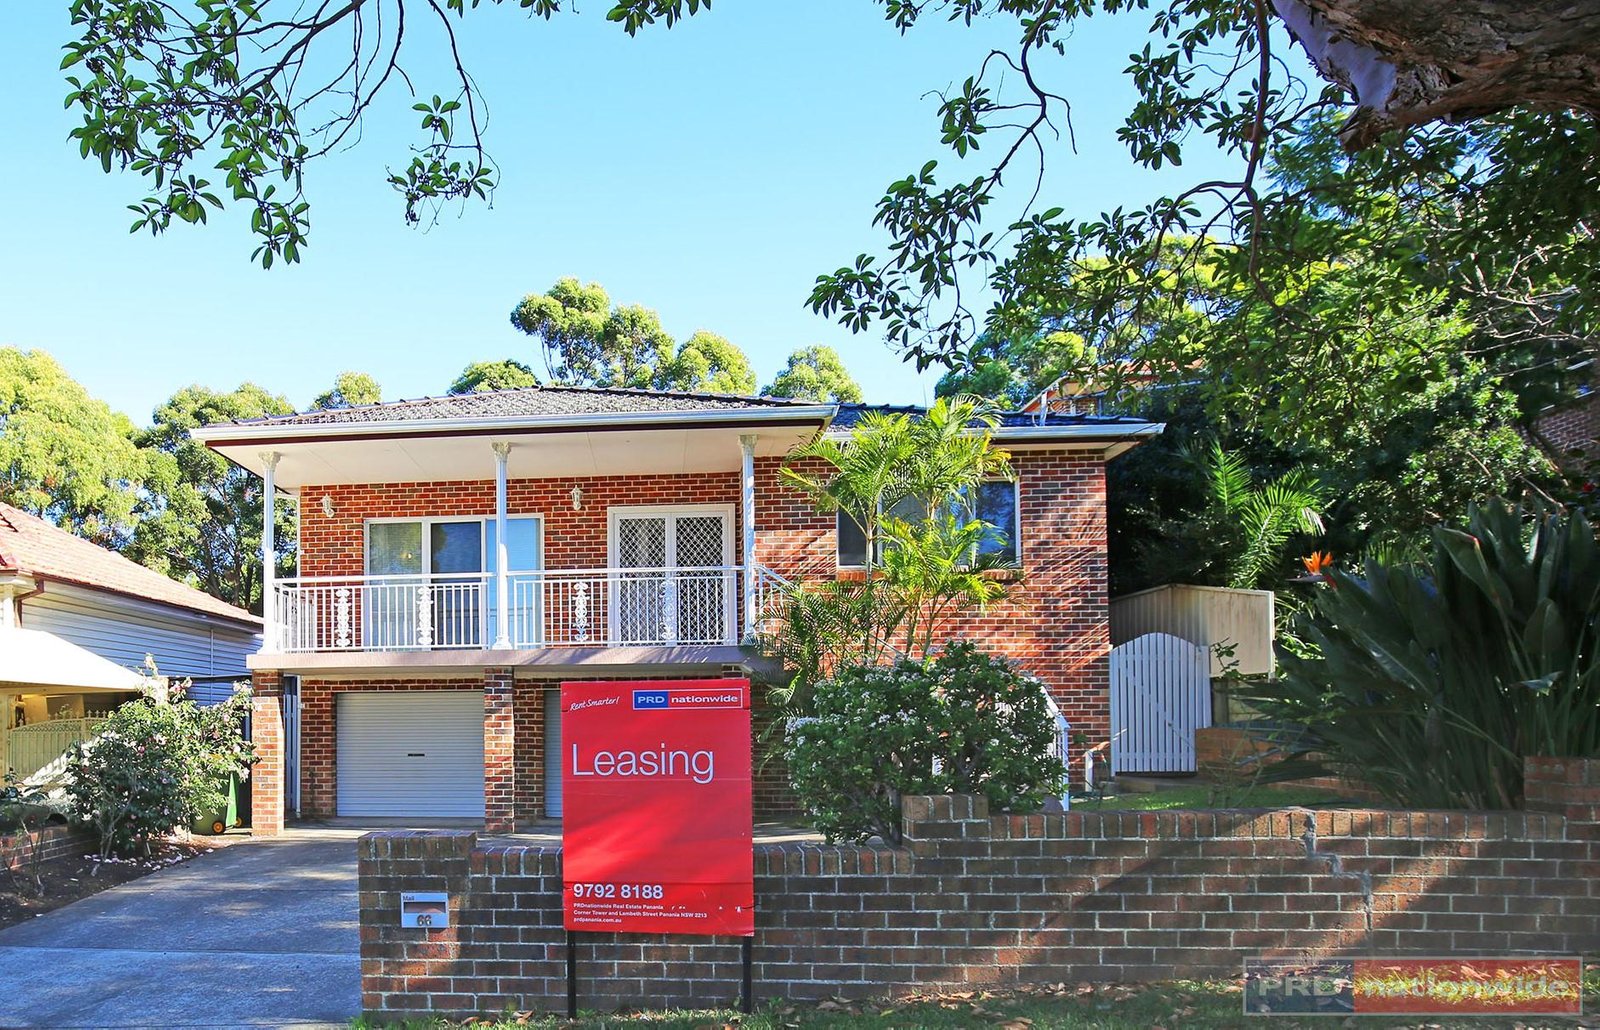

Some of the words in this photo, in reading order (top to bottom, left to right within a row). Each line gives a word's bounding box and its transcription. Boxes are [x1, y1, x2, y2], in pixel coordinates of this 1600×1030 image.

[570, 701, 586, 711] Rent
[586, 696, 620, 707] Smarter!
[638, 695, 665, 705] PRD
[671, 694, 738, 704] nationwide
[572, 742, 714, 784] Leasing
[573, 883, 616, 899] 9792
[620, 884, 664, 900] 8188
[416, 914, 432, 927] 66
